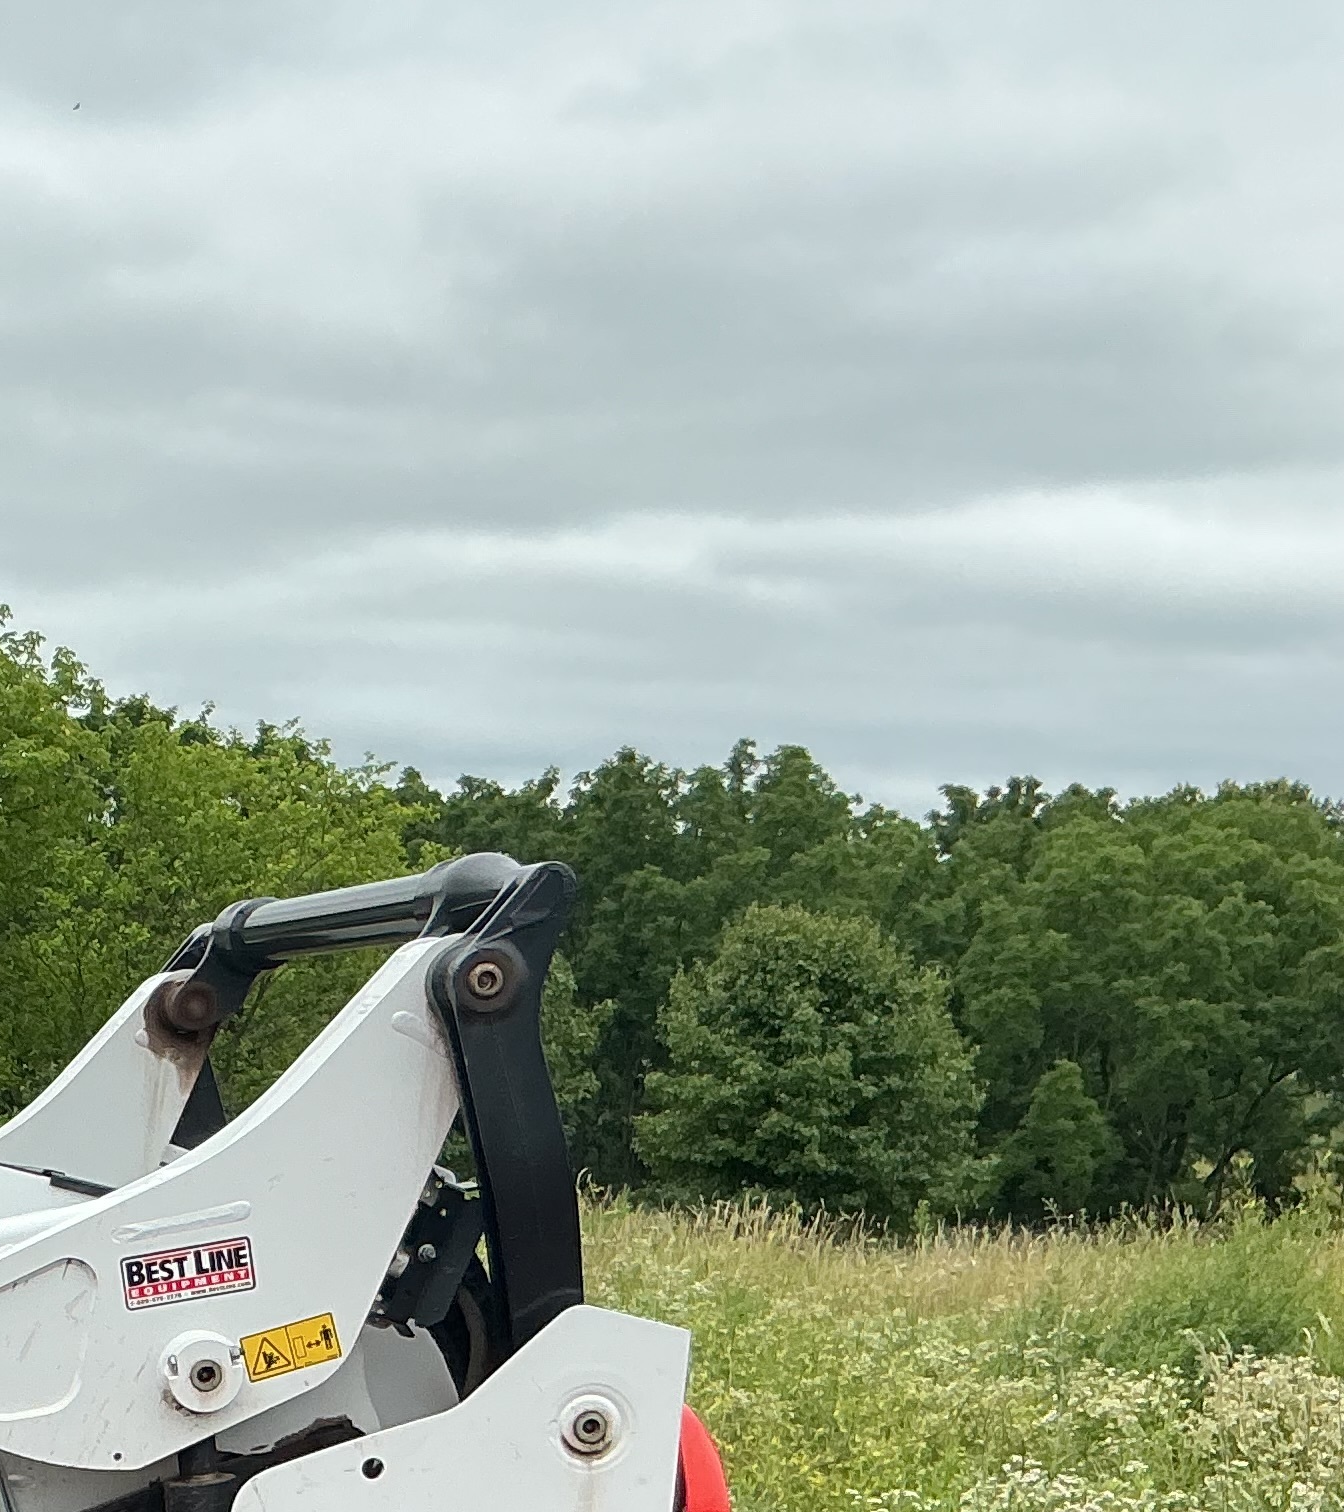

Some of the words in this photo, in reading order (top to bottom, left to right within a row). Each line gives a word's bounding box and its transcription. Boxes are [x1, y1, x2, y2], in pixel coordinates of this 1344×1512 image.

[125, 1256, 188, 1287] BEST
[193, 1246, 248, 1275] LINE
[131, 1269, 247, 1297] EQUIPMENT
